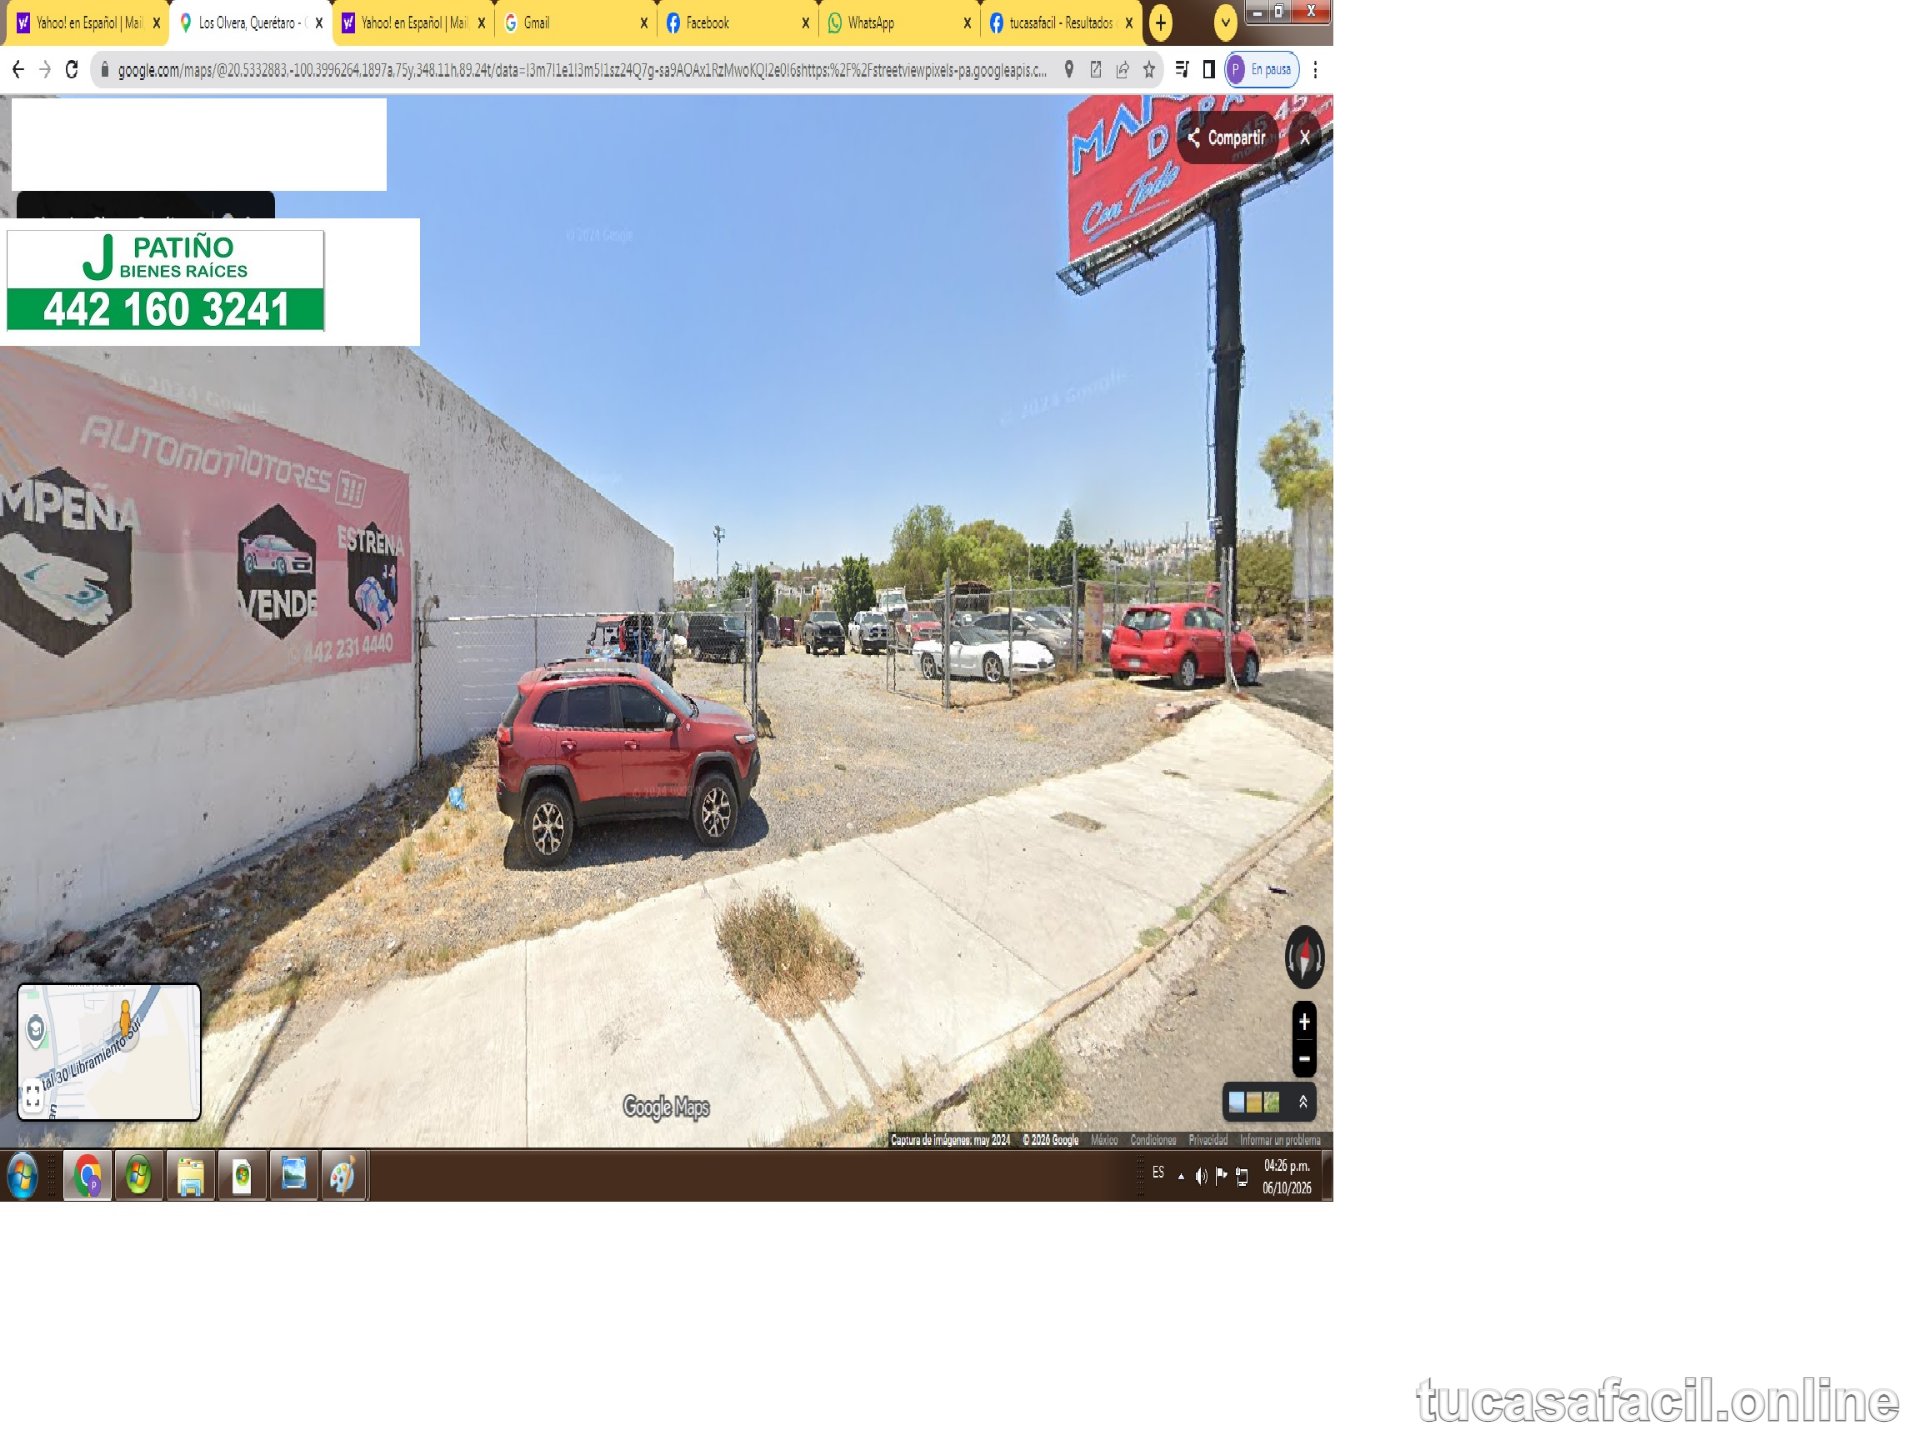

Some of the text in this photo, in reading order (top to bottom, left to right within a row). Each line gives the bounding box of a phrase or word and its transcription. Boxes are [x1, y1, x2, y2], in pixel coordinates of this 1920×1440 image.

[36, 15, 67, 30] Yahoo!
[69, 19, 81, 30] en
[83, 15, 118, 33] Español
[199, 15, 215, 30] Los
[216, 15, 248, 32] Olvera,
[250, 15, 294, 33] Querétaro
[361, 15, 392, 30] Yahoo!
[394, 19, 406, 30] en
[408, 15, 443, 33] Español
[524, 15, 550, 30] Gmail
[687, 15, 730, 30] Facebook
[847, 15, 895, 33] WhatsApp
[1009, 15, 1056, 30] tucasafacil
[1065, 15, 1114, 30] Resultados
[1251, 62, 1292, 79] En pausa
[1207, 129, 1267, 150] Compartir
[337, 524, 406, 557] ESTRENA
[237, 588, 317, 622] VENDE
[303, 634, 394, 664] 442 231 4440
[56, 1069, 70, 1085] 30
[70, 1037, 127, 1079] Libramiento
[891, 1133, 1012, 1150] Captura de imágenes: may 2024
[1022, 1133, 1080, 1149] © 2026 Google
[1091, 1133, 1119, 1147] México
[1130, 1133, 1177, 1147] Condiciones
[1189, 1133, 1229, 1147] Privacidad
[1240, 1133, 1322, 1149] Informar un problema
[1152, 1165, 1165, 1179] ES
[1264, 1158, 1311, 1176] 04:26 p.m.
[1262, 1181, 1312, 1196] 06/10/2026
